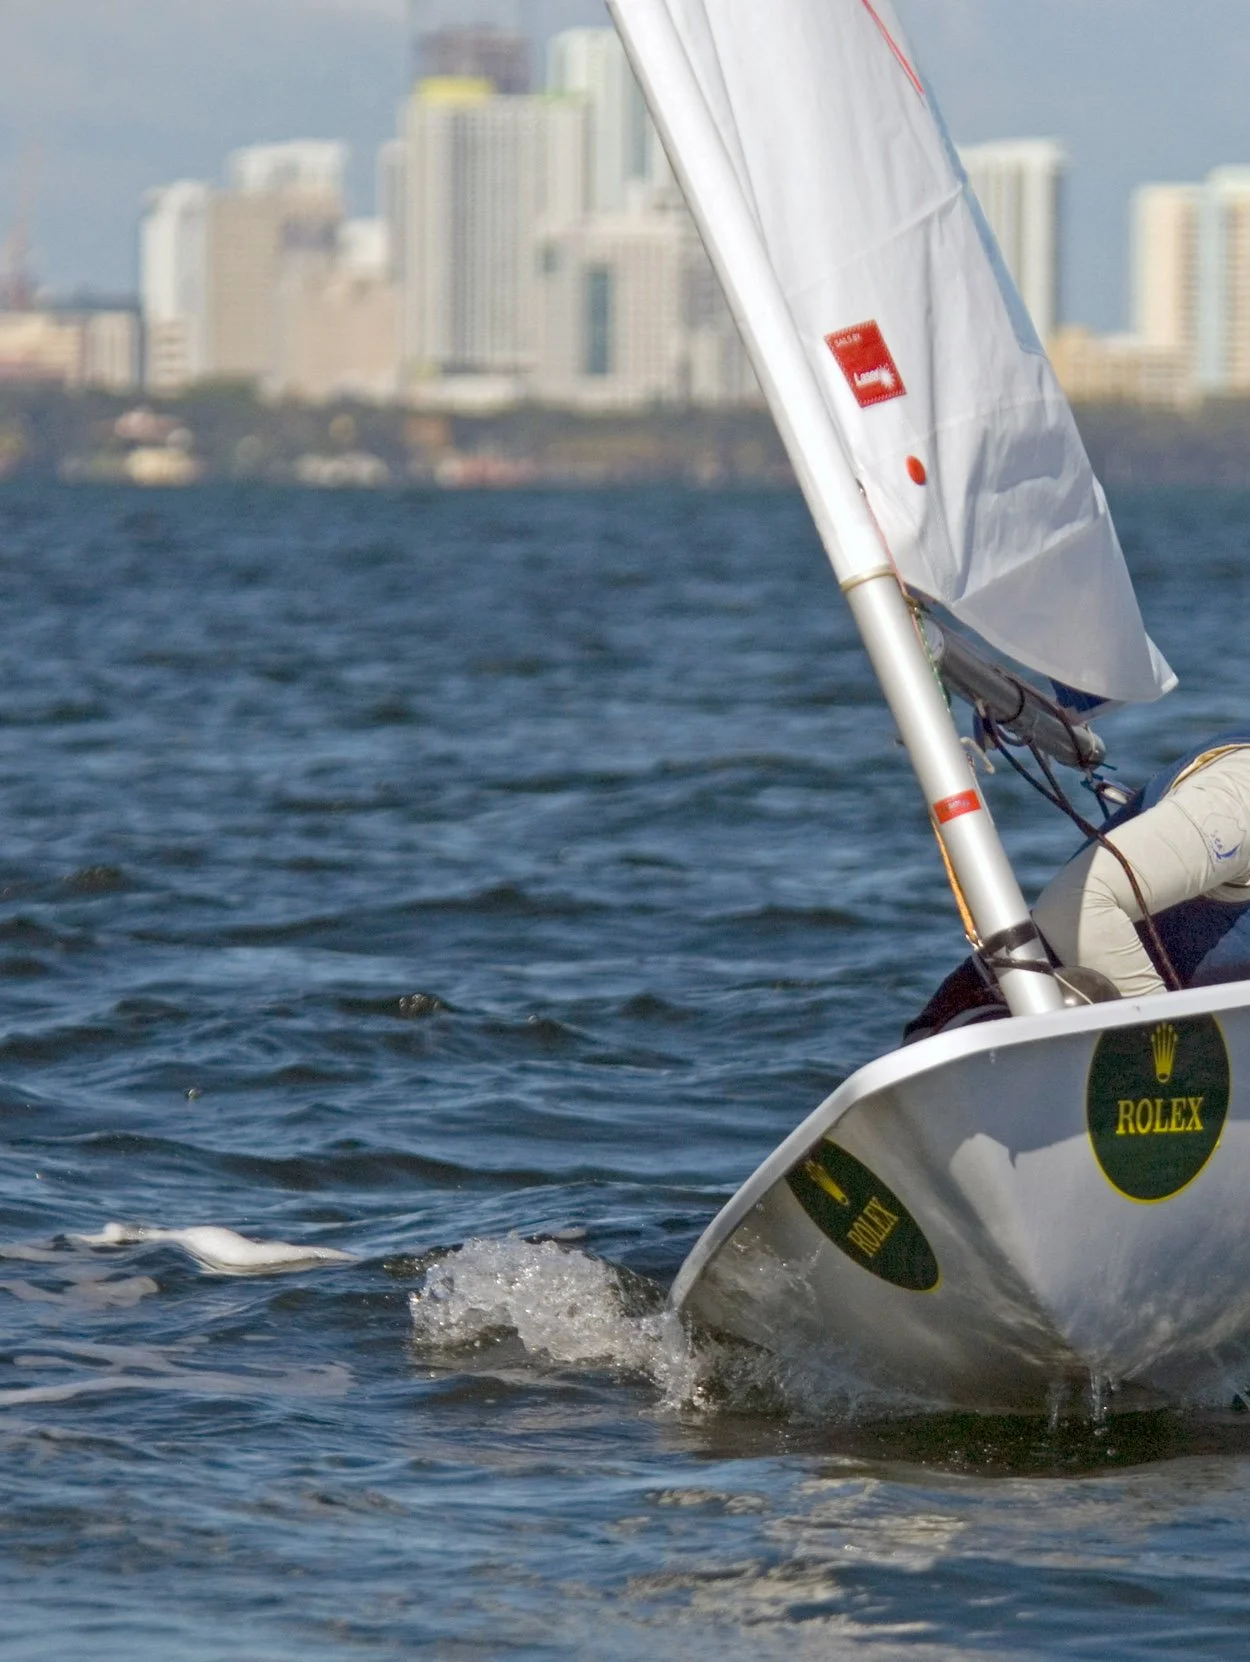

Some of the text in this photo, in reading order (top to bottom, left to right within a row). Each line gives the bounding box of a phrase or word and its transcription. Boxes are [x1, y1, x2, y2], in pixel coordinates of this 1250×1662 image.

[853, 369, 881, 387] Laser
[1115, 1097, 1204, 1135] ROLEX
[847, 1196, 898, 1258] ROLEX
